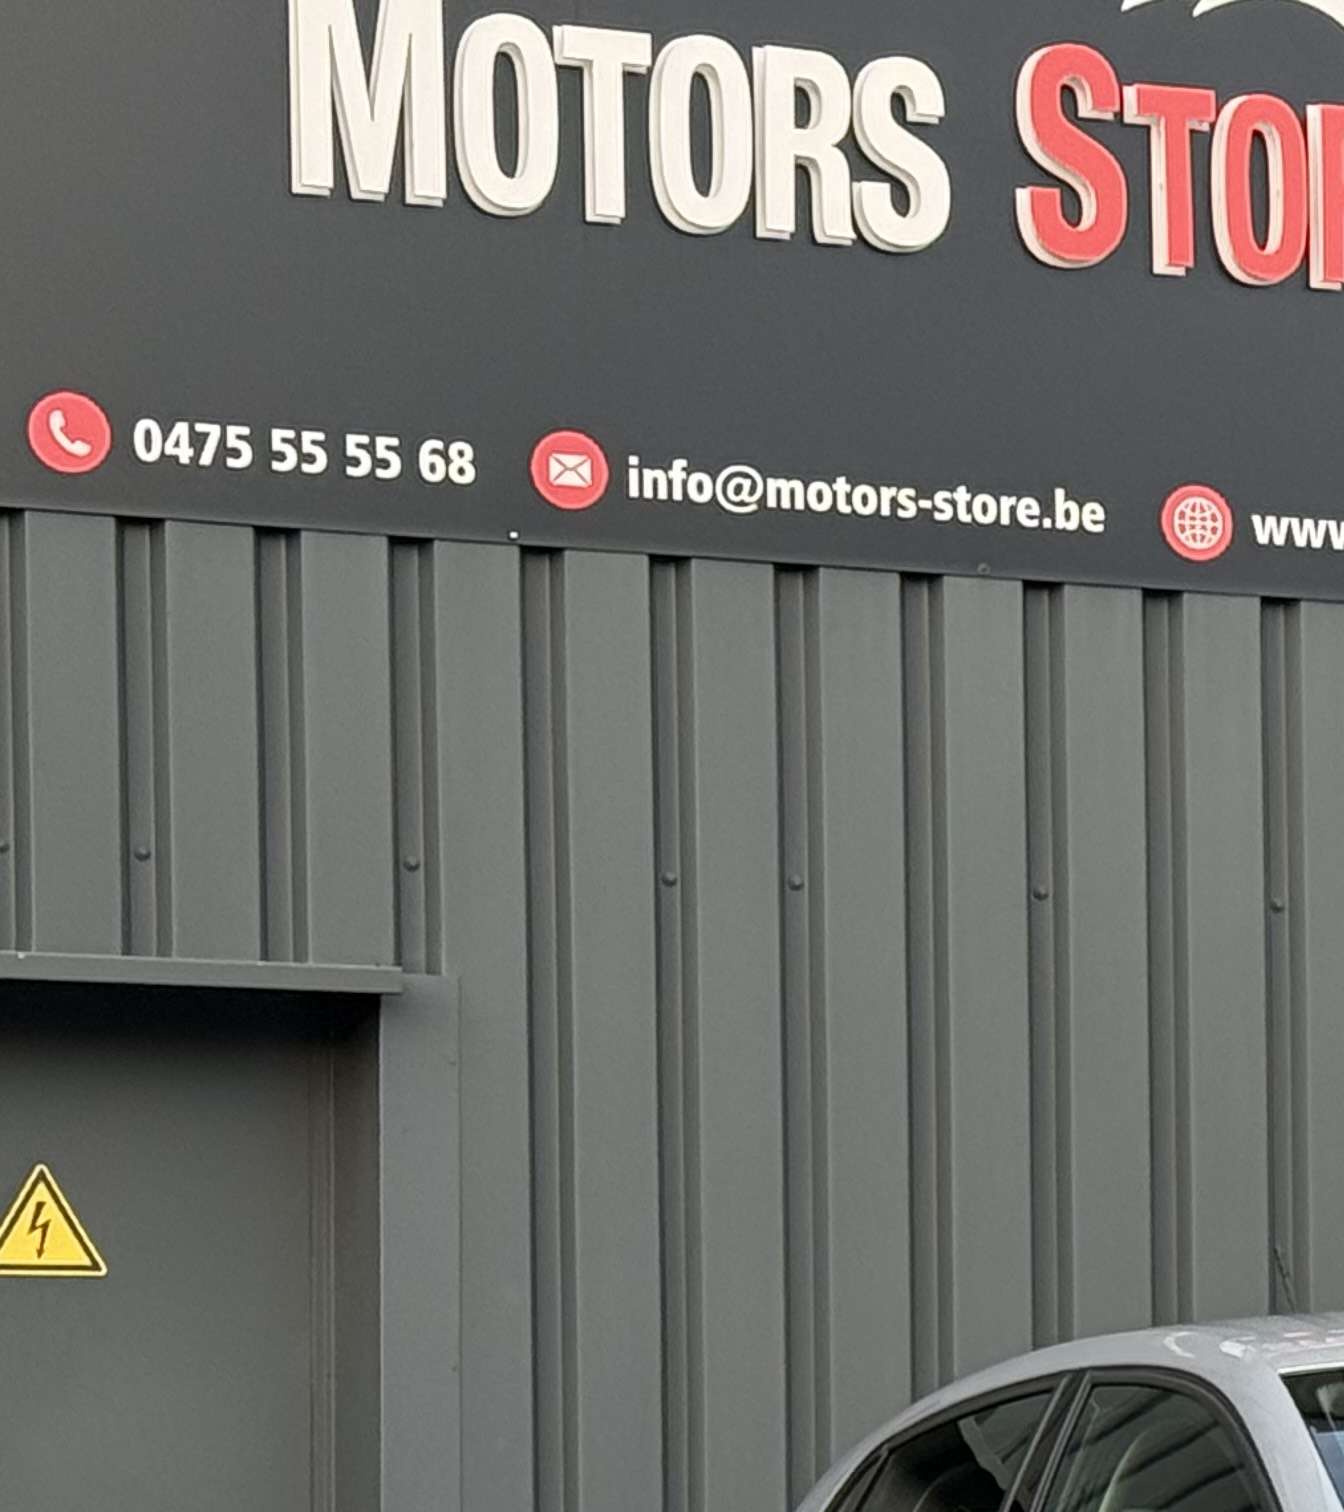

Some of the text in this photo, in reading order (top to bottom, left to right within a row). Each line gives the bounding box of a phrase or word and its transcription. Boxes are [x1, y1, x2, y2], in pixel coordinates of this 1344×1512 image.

[133, 418, 477, 485] 0475 55 55 68
[627, 456, 1107, 534] info@motors-store.be
